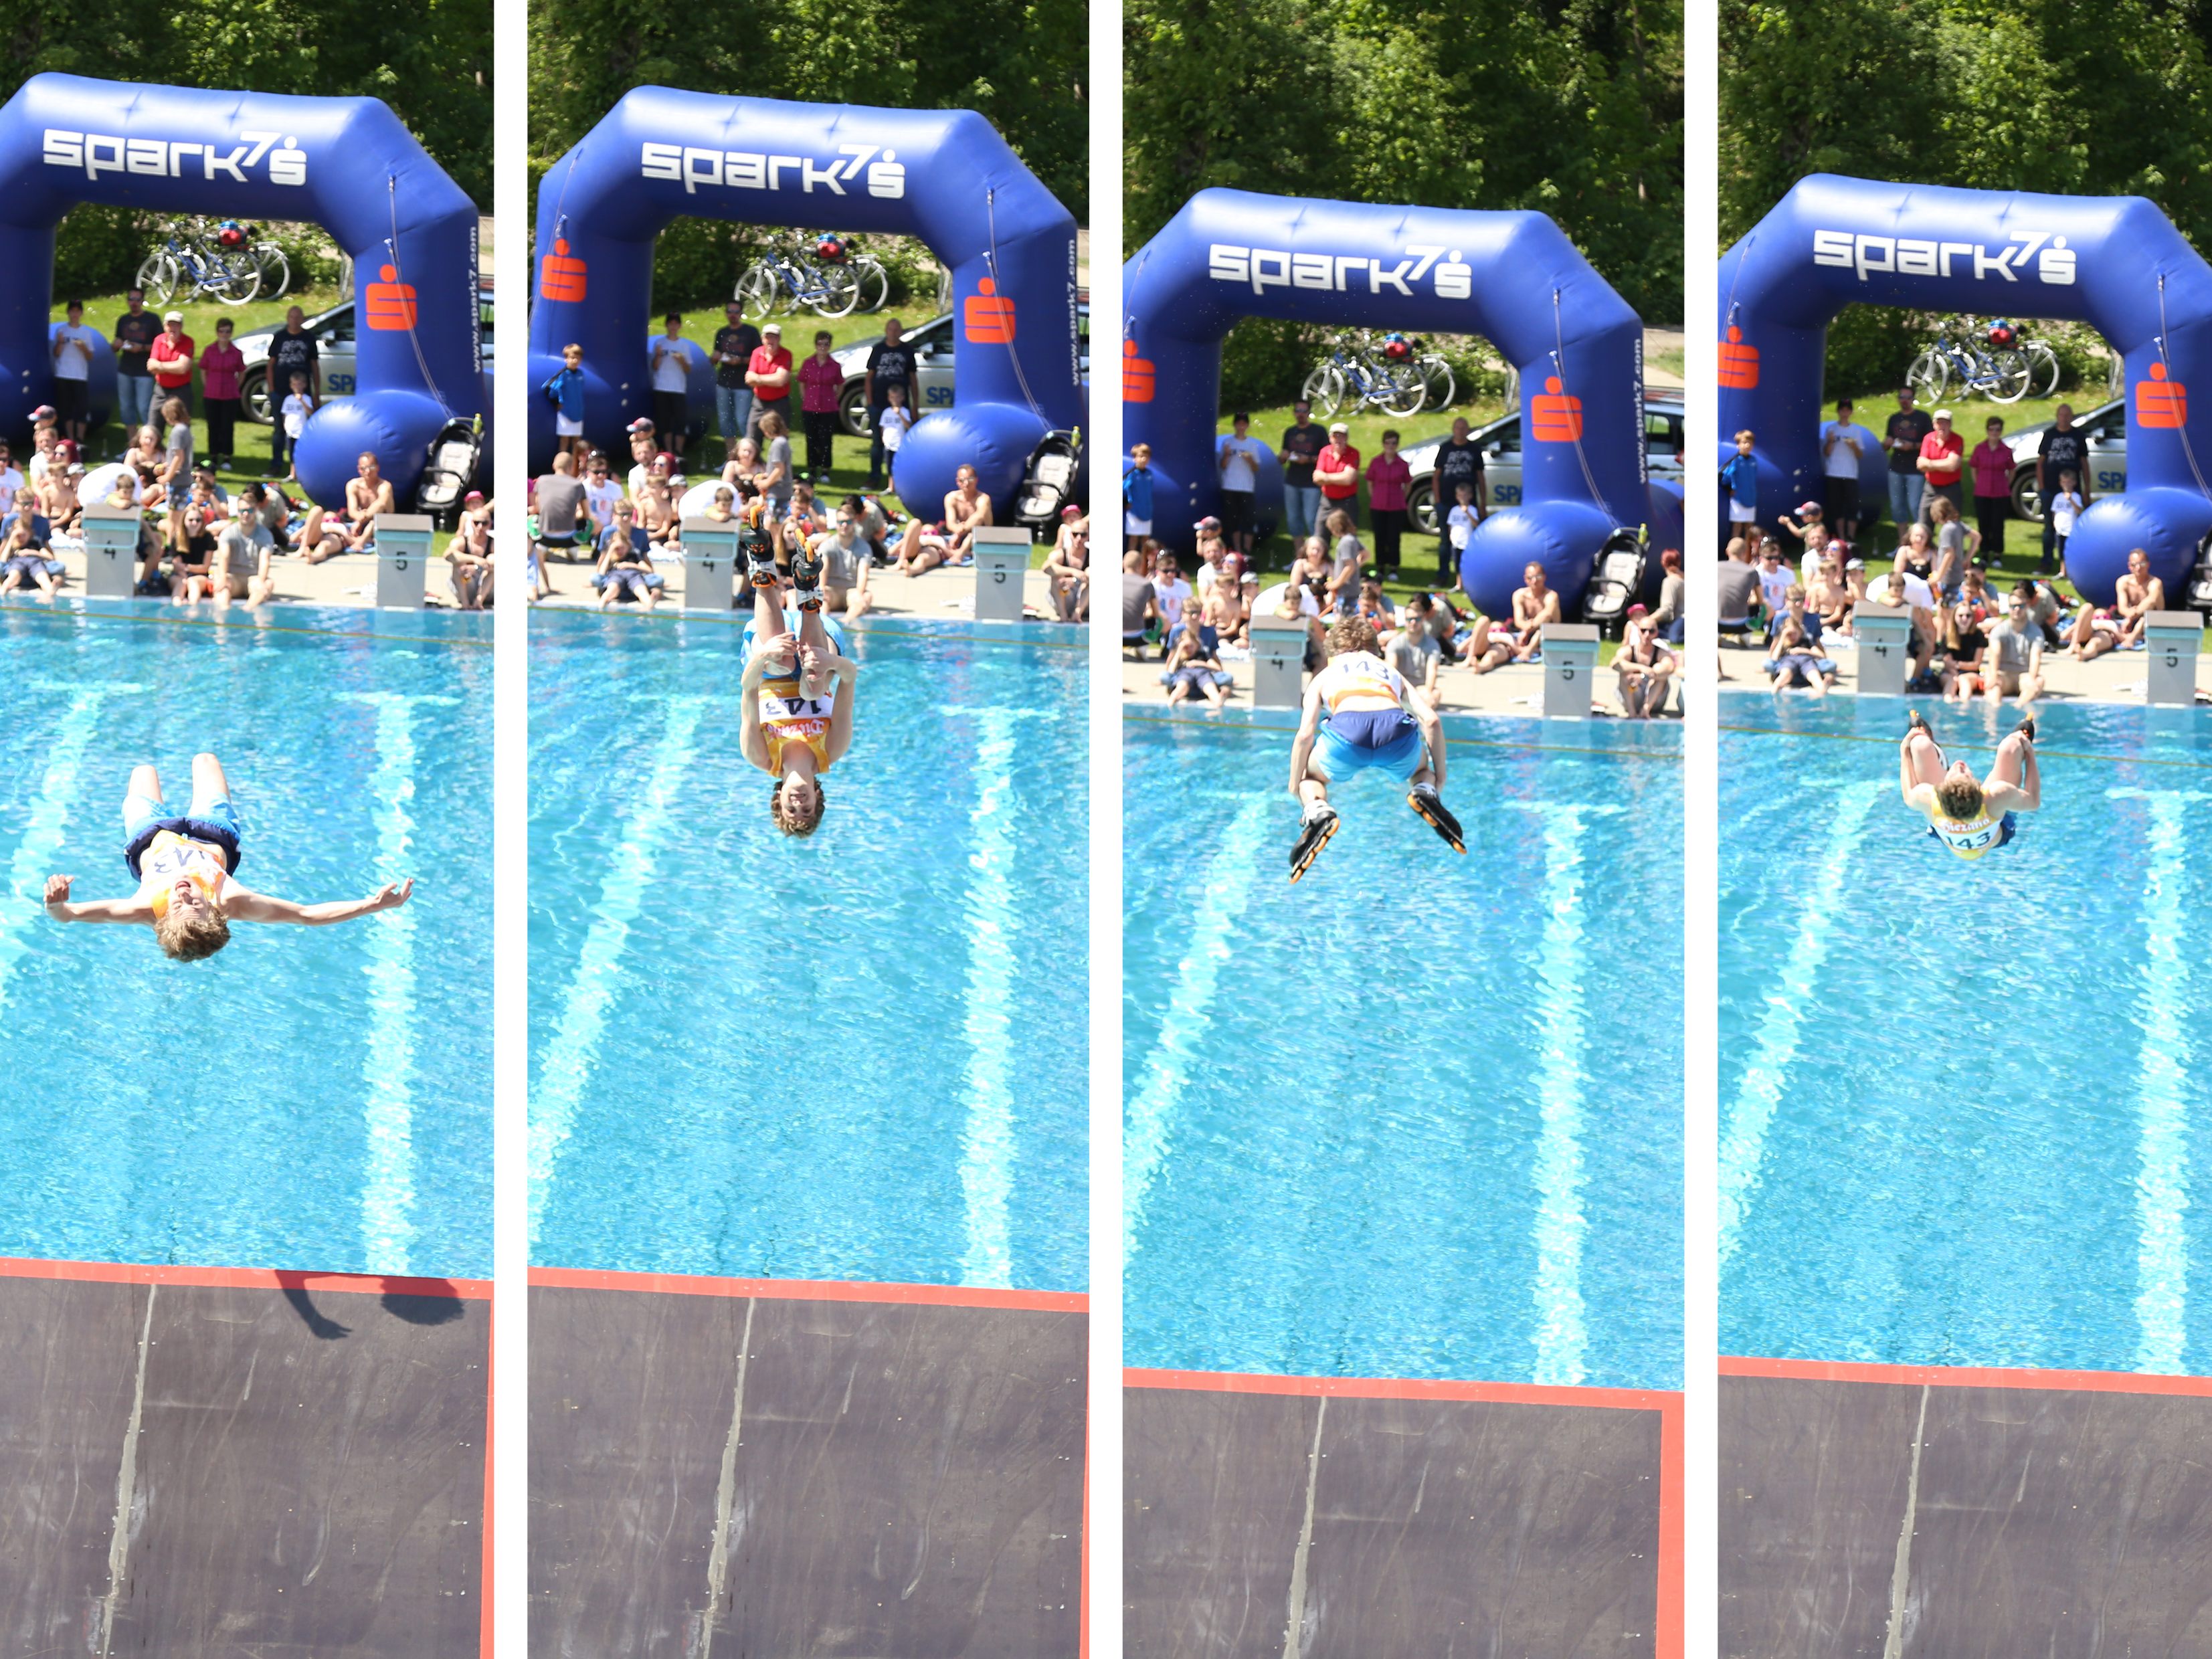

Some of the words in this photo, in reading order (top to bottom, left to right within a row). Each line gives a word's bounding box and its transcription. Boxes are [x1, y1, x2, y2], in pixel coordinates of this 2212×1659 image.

[468, 226, 481, 373] www.spark7.com
[1067, 239, 1080, 386] www.spark7.com
[1633, 338, 1647, 484] www.spark7.com
[104, 540, 116, 559] 4
[396, 551, 407, 571] 5
[702, 553, 715, 573] 4
[994, 563, 1006, 583] 5
[1875, 638, 1887, 658] 4
[2167, 648, 2179, 668] 5
[1271, 650, 1283, 670] 4
[1563, 660, 1574, 680] 5
[765, 697, 822, 715] 143
[1945, 832, 1991, 850] 143
